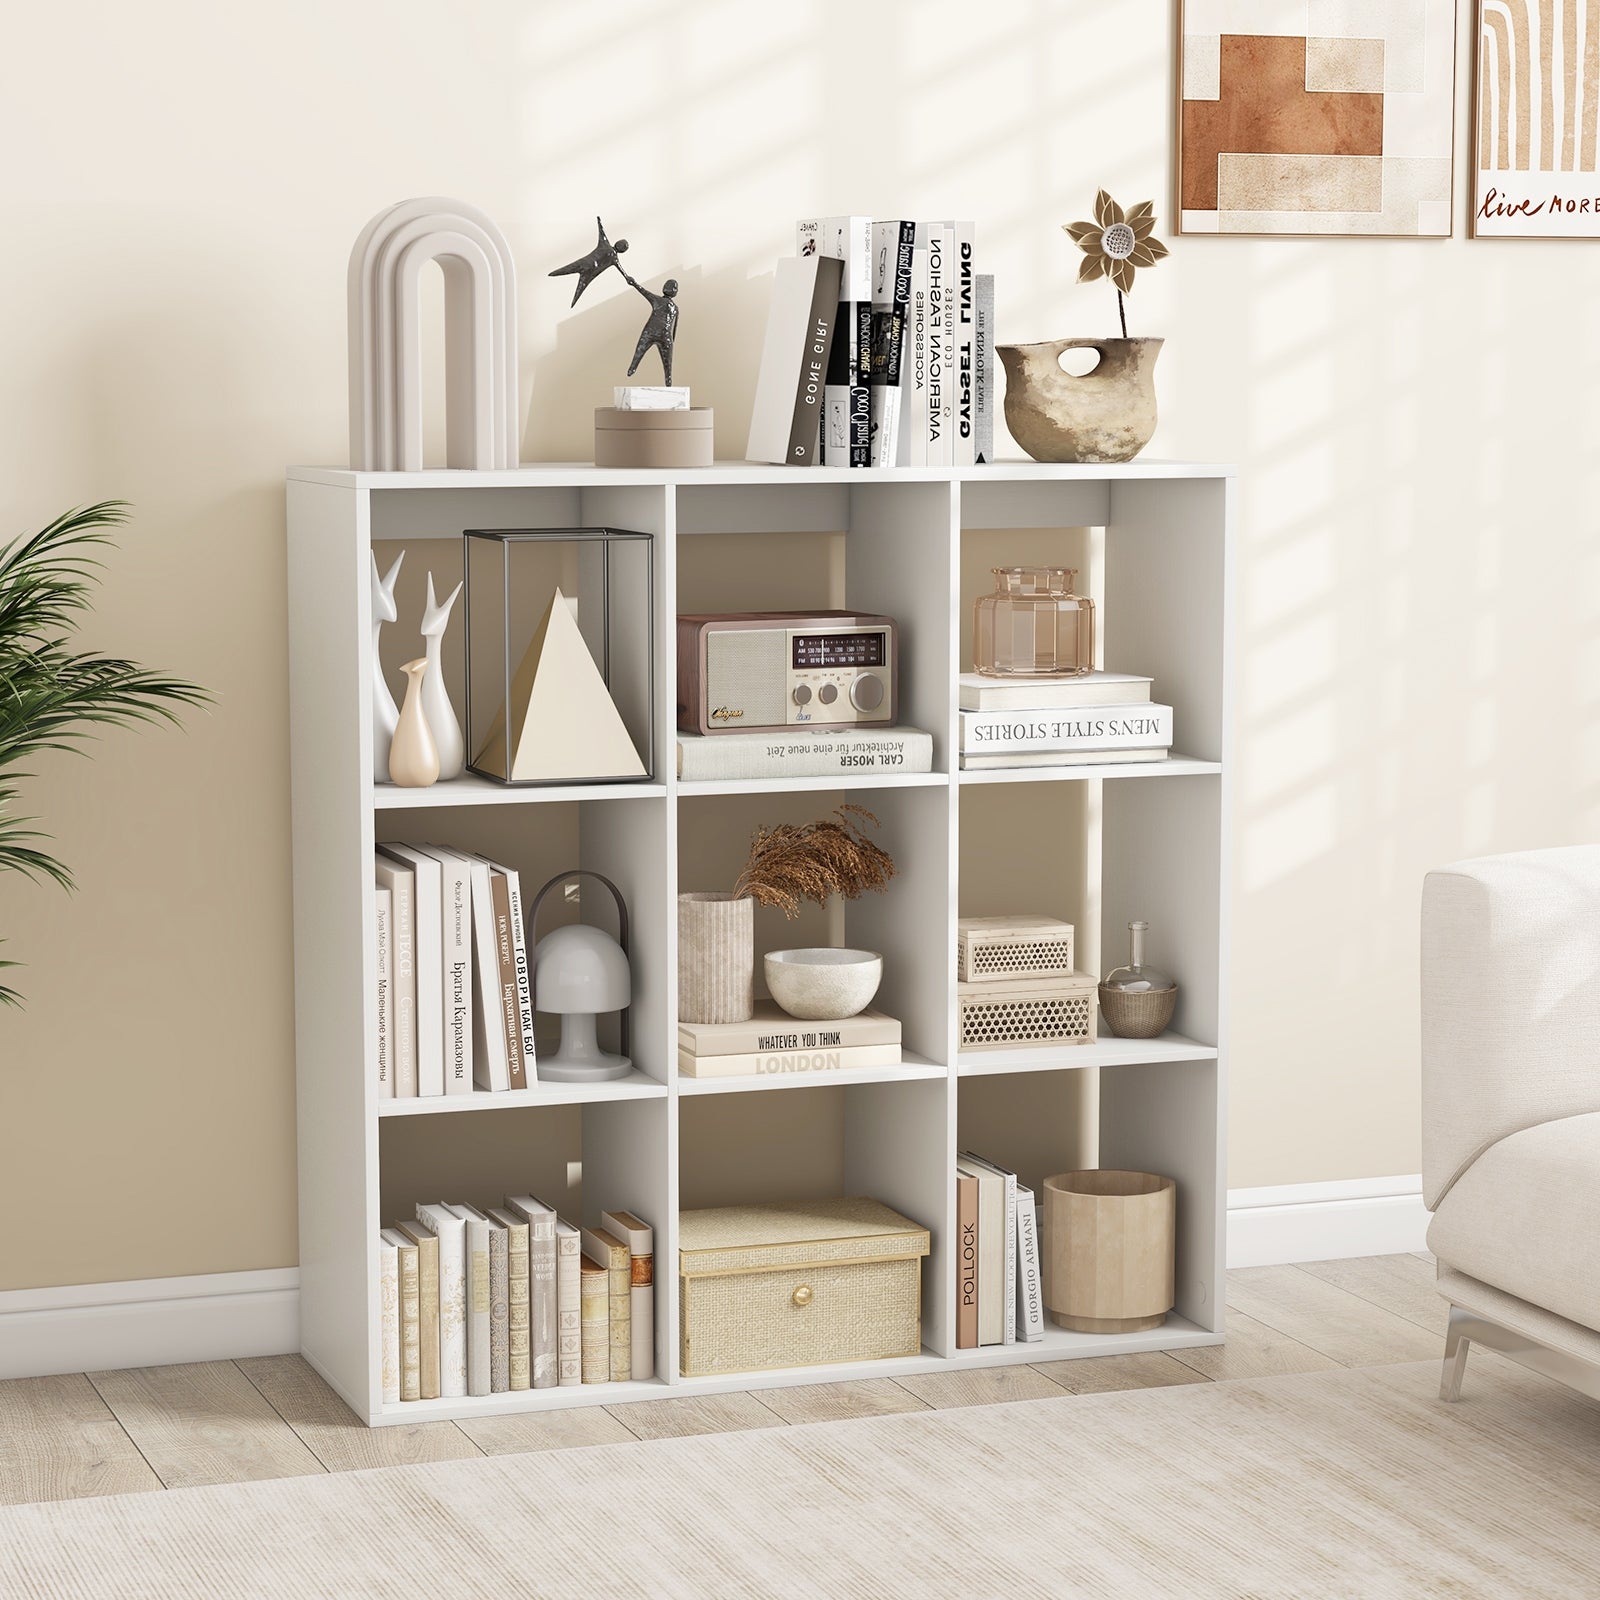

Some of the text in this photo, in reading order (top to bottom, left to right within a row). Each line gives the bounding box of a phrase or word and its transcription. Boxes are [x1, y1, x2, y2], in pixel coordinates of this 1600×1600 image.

[1477, 187, 1600, 218] live MORE
[974, 718, 1160, 741] MEN'S STYLE STORIES
[766, 742, 904, 758] Architektur für eine neue Zeit
[840, 754, 904, 766] CARL MOSER
[450, 962, 466, 1004] Братья
[516, 948, 529, 1004] ГОВОРИ
[378, 979, 387, 1033] Маленькие
[503, 983, 516, 1038] Бархатная
[521, 1009, 532, 1032] КАК
[378, 1035, 388, 1082] женщины
[450, 1006, 466, 1079] Карамазовы
[508, 1038, 521, 1075] смерть
[524, 1036, 534, 1057] БОГ
[758, 1032, 841, 1050] WHATEVER YOU THINK
[756, 1053, 841, 1075] LONDON
[963, 1222, 975, 1306] POLLOCK
[1023, 1213, 1039, 1323] GIORGIO ARMANI
